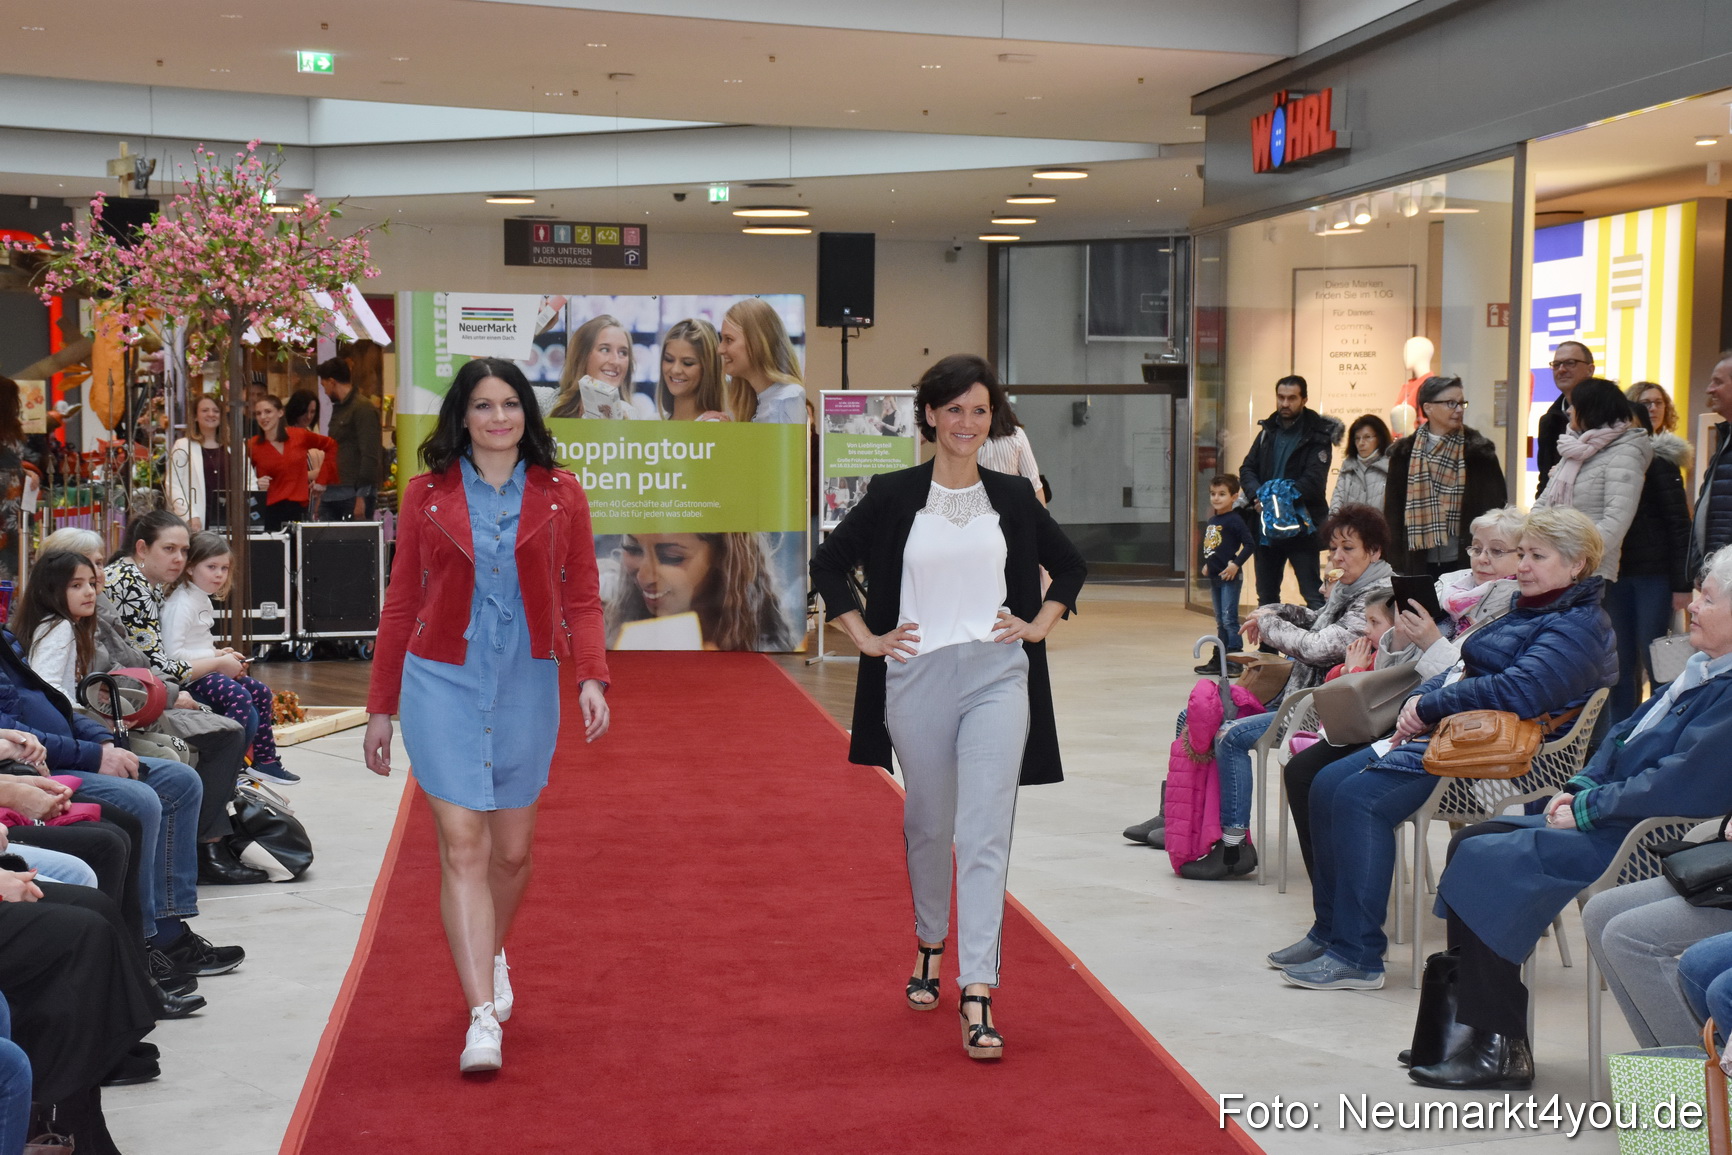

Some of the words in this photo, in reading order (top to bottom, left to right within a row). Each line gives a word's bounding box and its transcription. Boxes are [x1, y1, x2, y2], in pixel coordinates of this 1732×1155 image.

[1251, 87, 1337, 174] WÖHRL
[558, 248, 592, 256] UNTEREN
[533, 256, 592, 266] LADENSTRASSE
[1325, 281, 1350, 289] Diese
[1352, 280, 1383, 289] Marken
[1315, 291, 1341, 299] finden
[1344, 291, 1357, 299] Sie
[458, 322, 517, 333] NeuerMarkt
[1338, 363, 1367, 371] BRAX
[552, 437, 716, 466] hoppingtour
[638, 470, 687, 495] pur.
[589, 500, 609, 508] effen
[609, 500, 620, 508] 40
[621, 500, 659, 508] Geschäfte
[660, 500, 672, 508] auf
[590, 510, 608, 518] udio.
[609, 510, 619, 518] Da
[621, 510, 629, 518] ist
[631, 510, 642, 518] für
[643, 510, 665, 520] jeden
[682, 510, 703, 518] dabei.
